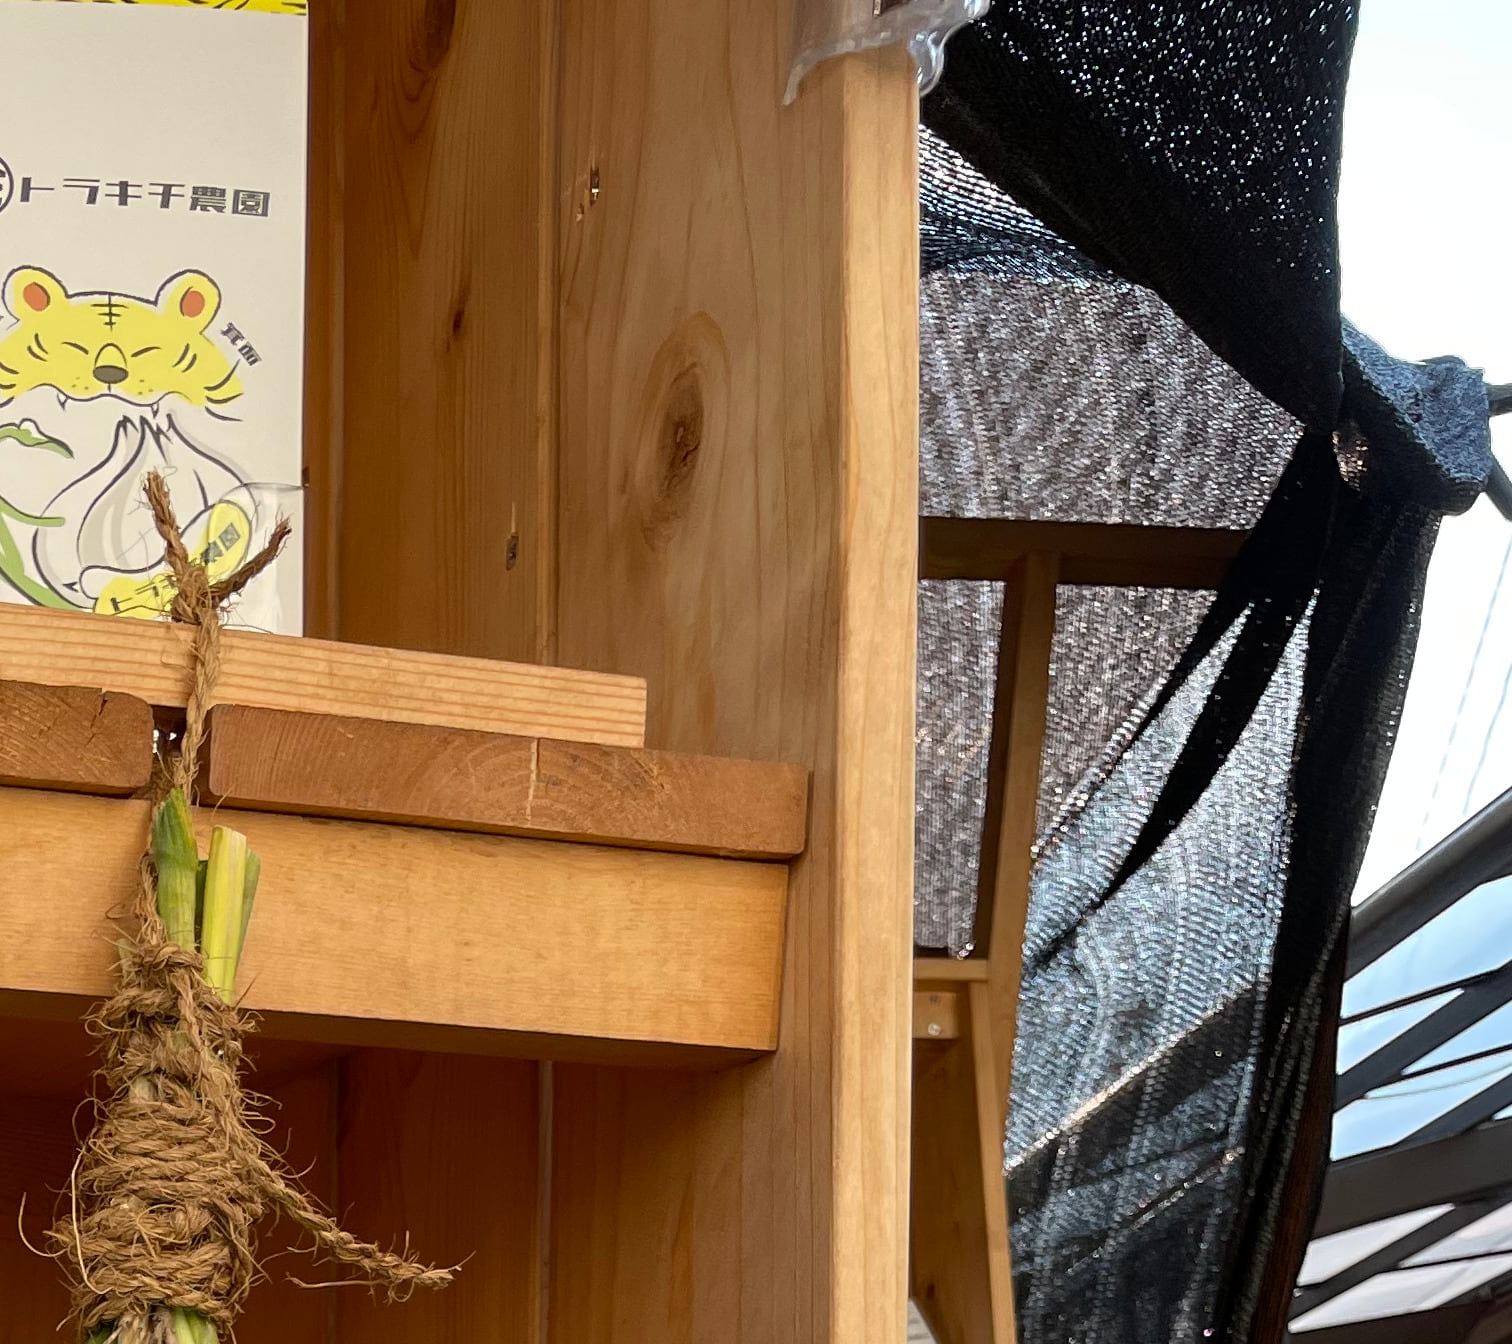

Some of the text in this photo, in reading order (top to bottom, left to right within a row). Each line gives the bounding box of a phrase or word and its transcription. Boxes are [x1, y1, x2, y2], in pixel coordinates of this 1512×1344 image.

[20, 176, 270, 217] トラキチ農園
